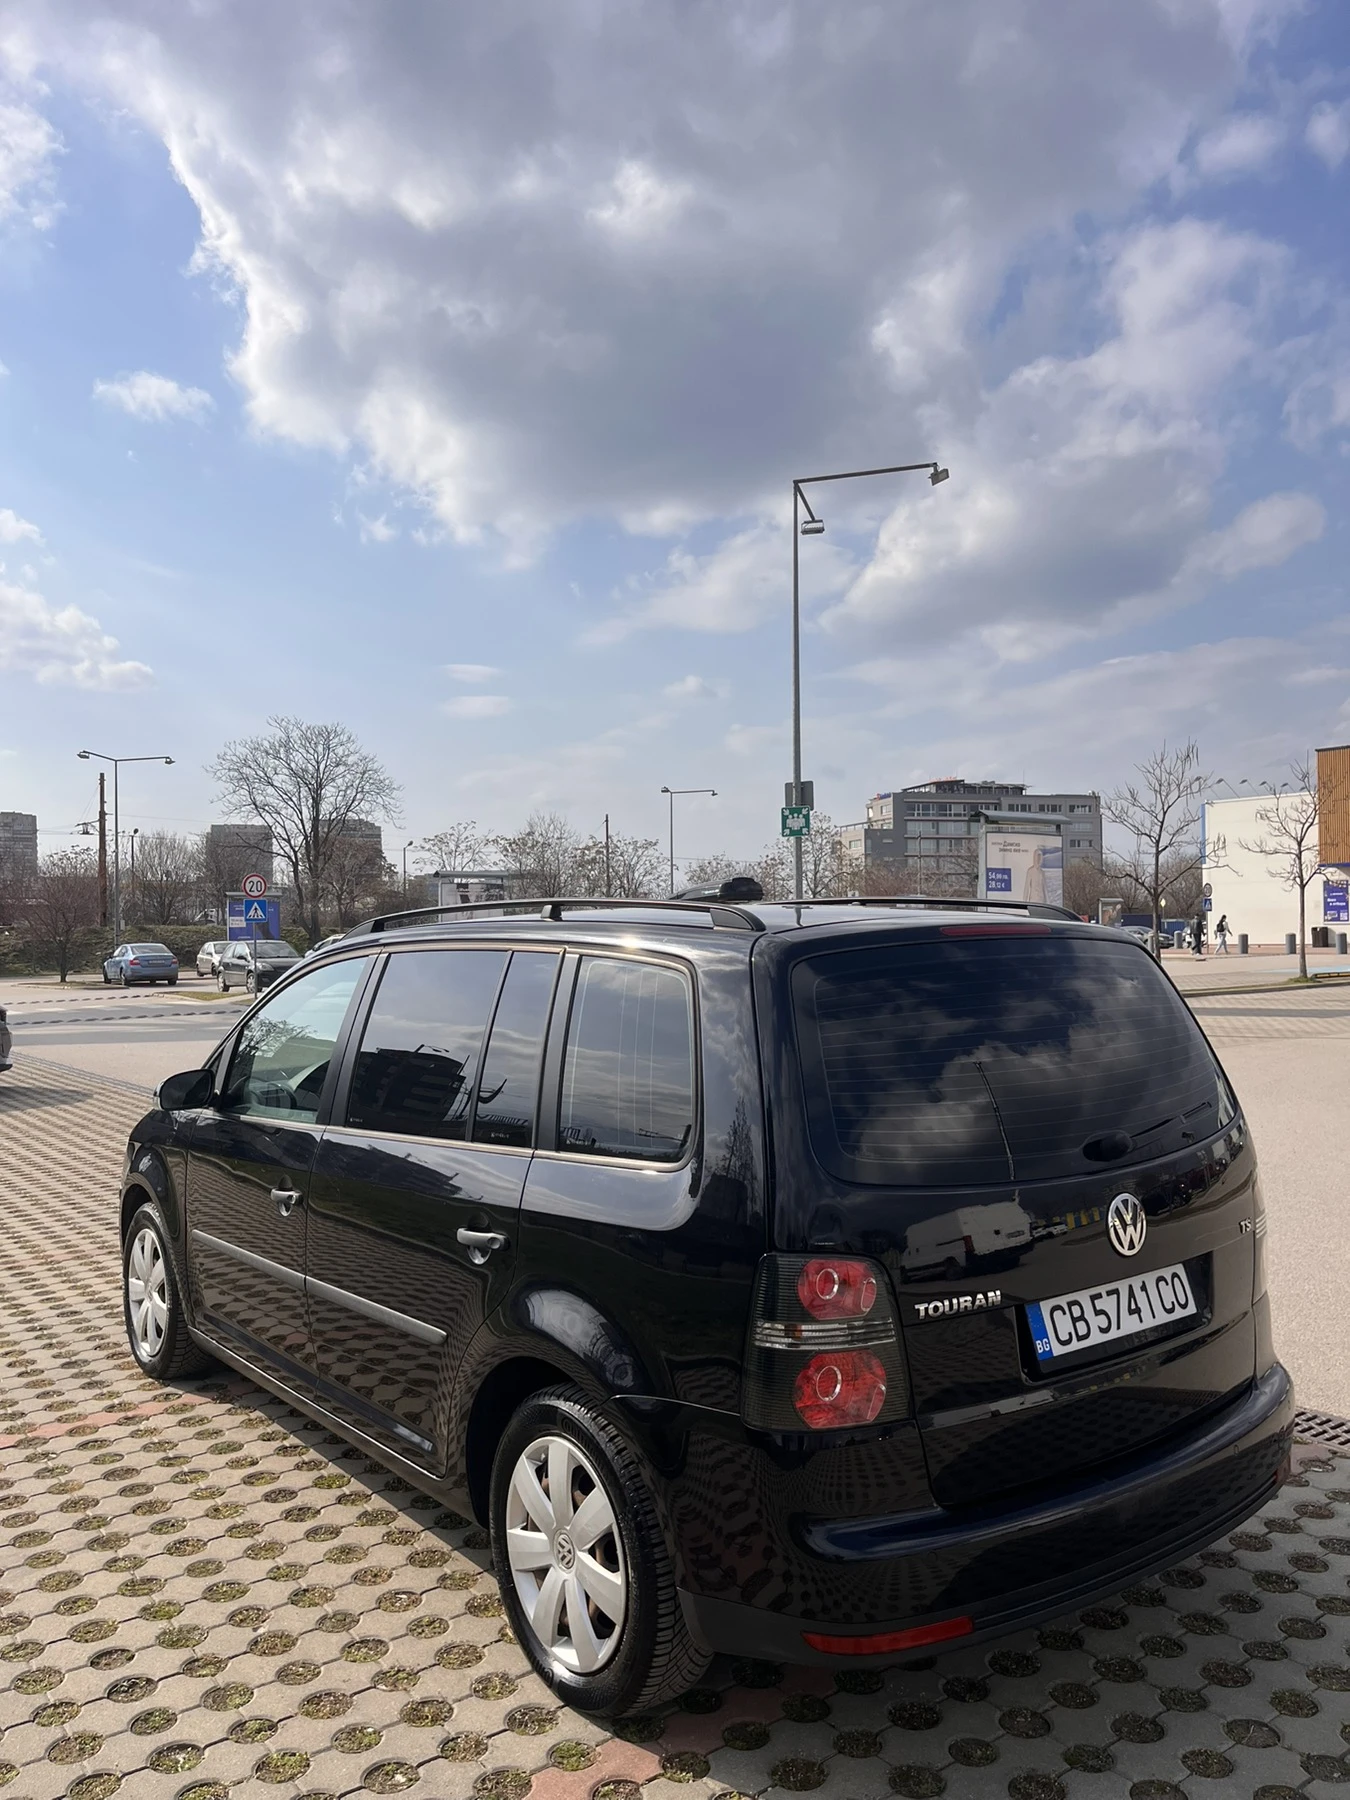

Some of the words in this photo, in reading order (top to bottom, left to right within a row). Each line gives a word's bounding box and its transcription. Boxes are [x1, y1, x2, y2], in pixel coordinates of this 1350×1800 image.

[248, 880, 263, 893] 20
[914, 1290, 1001, 1319] TOURAN
[1036, 1338, 1050, 1353] BG
